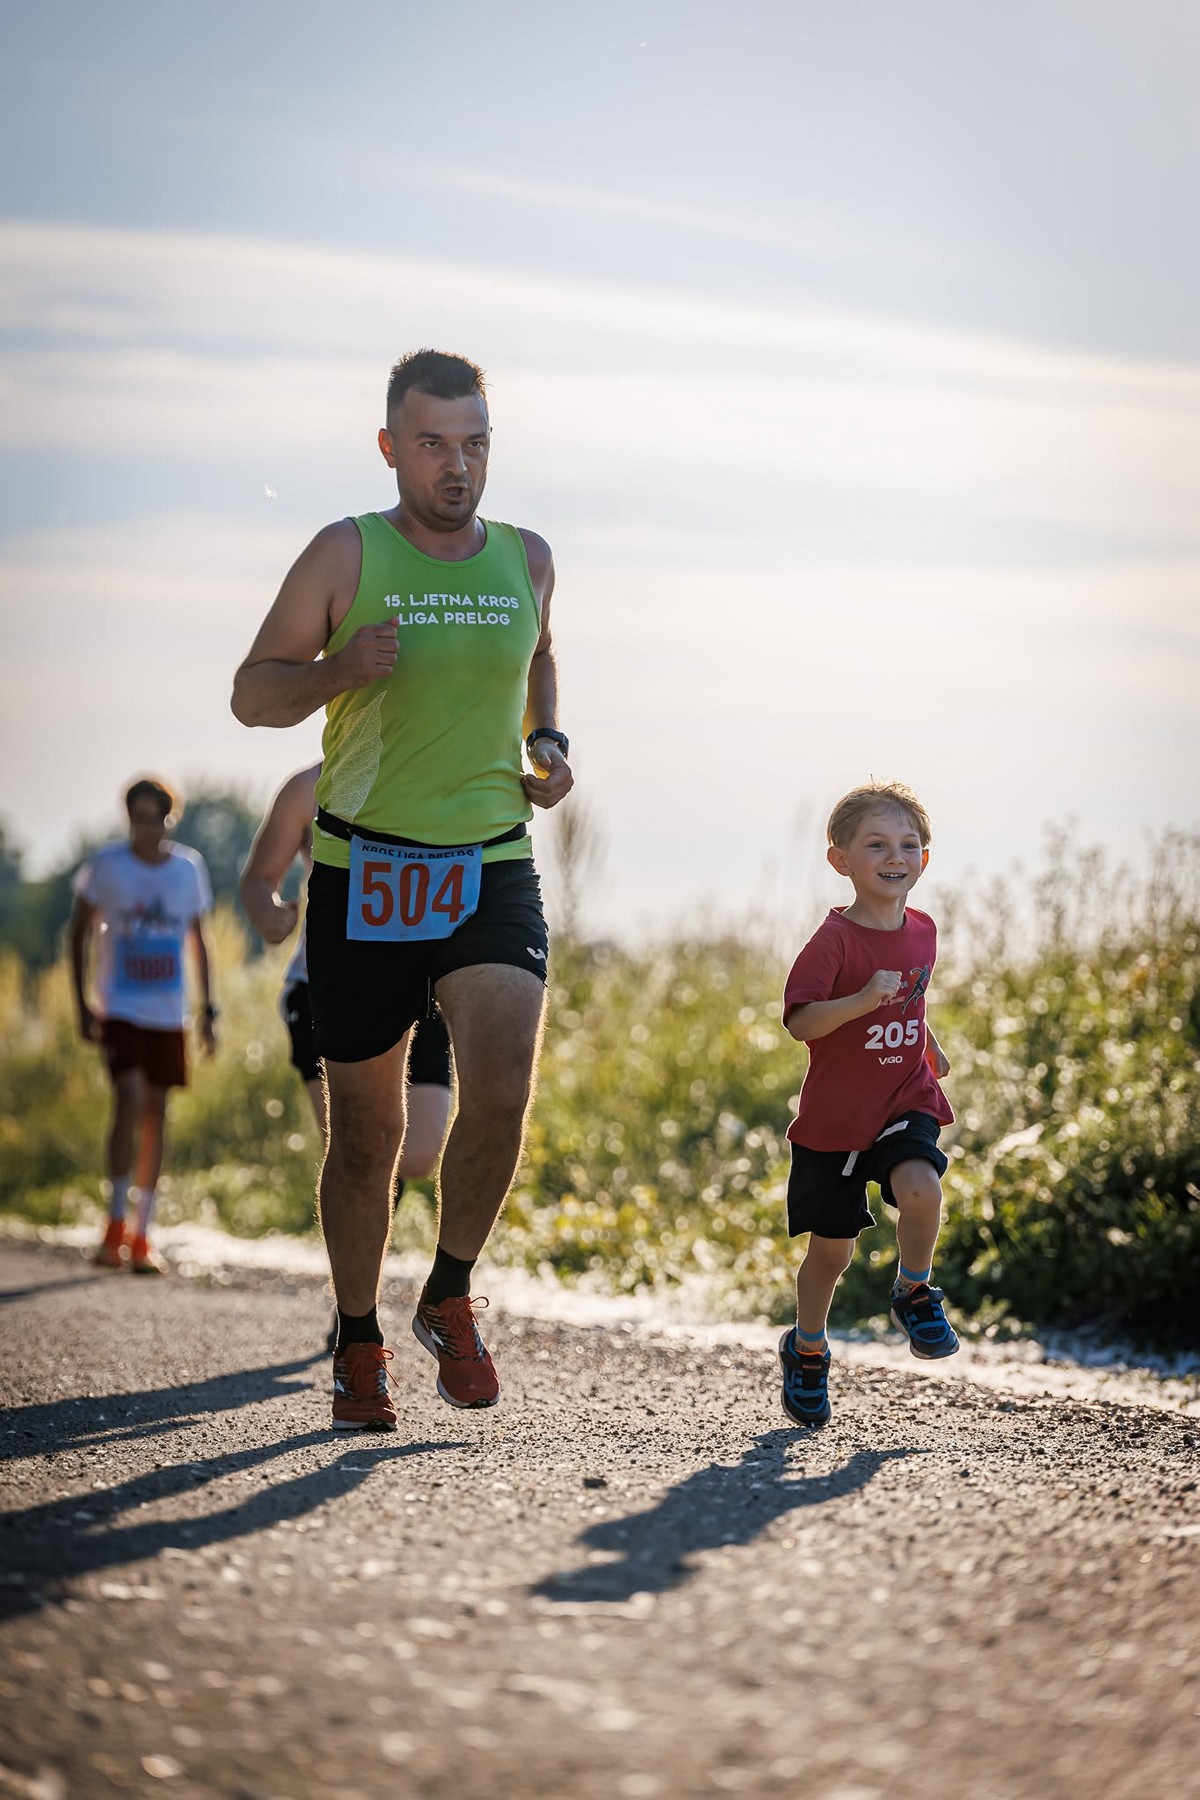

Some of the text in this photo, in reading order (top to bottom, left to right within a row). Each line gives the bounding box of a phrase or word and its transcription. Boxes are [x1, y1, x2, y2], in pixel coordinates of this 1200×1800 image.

[384, 593, 519, 609] 15. LJETNA KROS
[398, 612, 510, 626] LIGA PRELOG
[362, 861, 465, 927] 504
[864, 1019, 919, 1050] 205
[878, 1055, 903, 1066] VIGO
